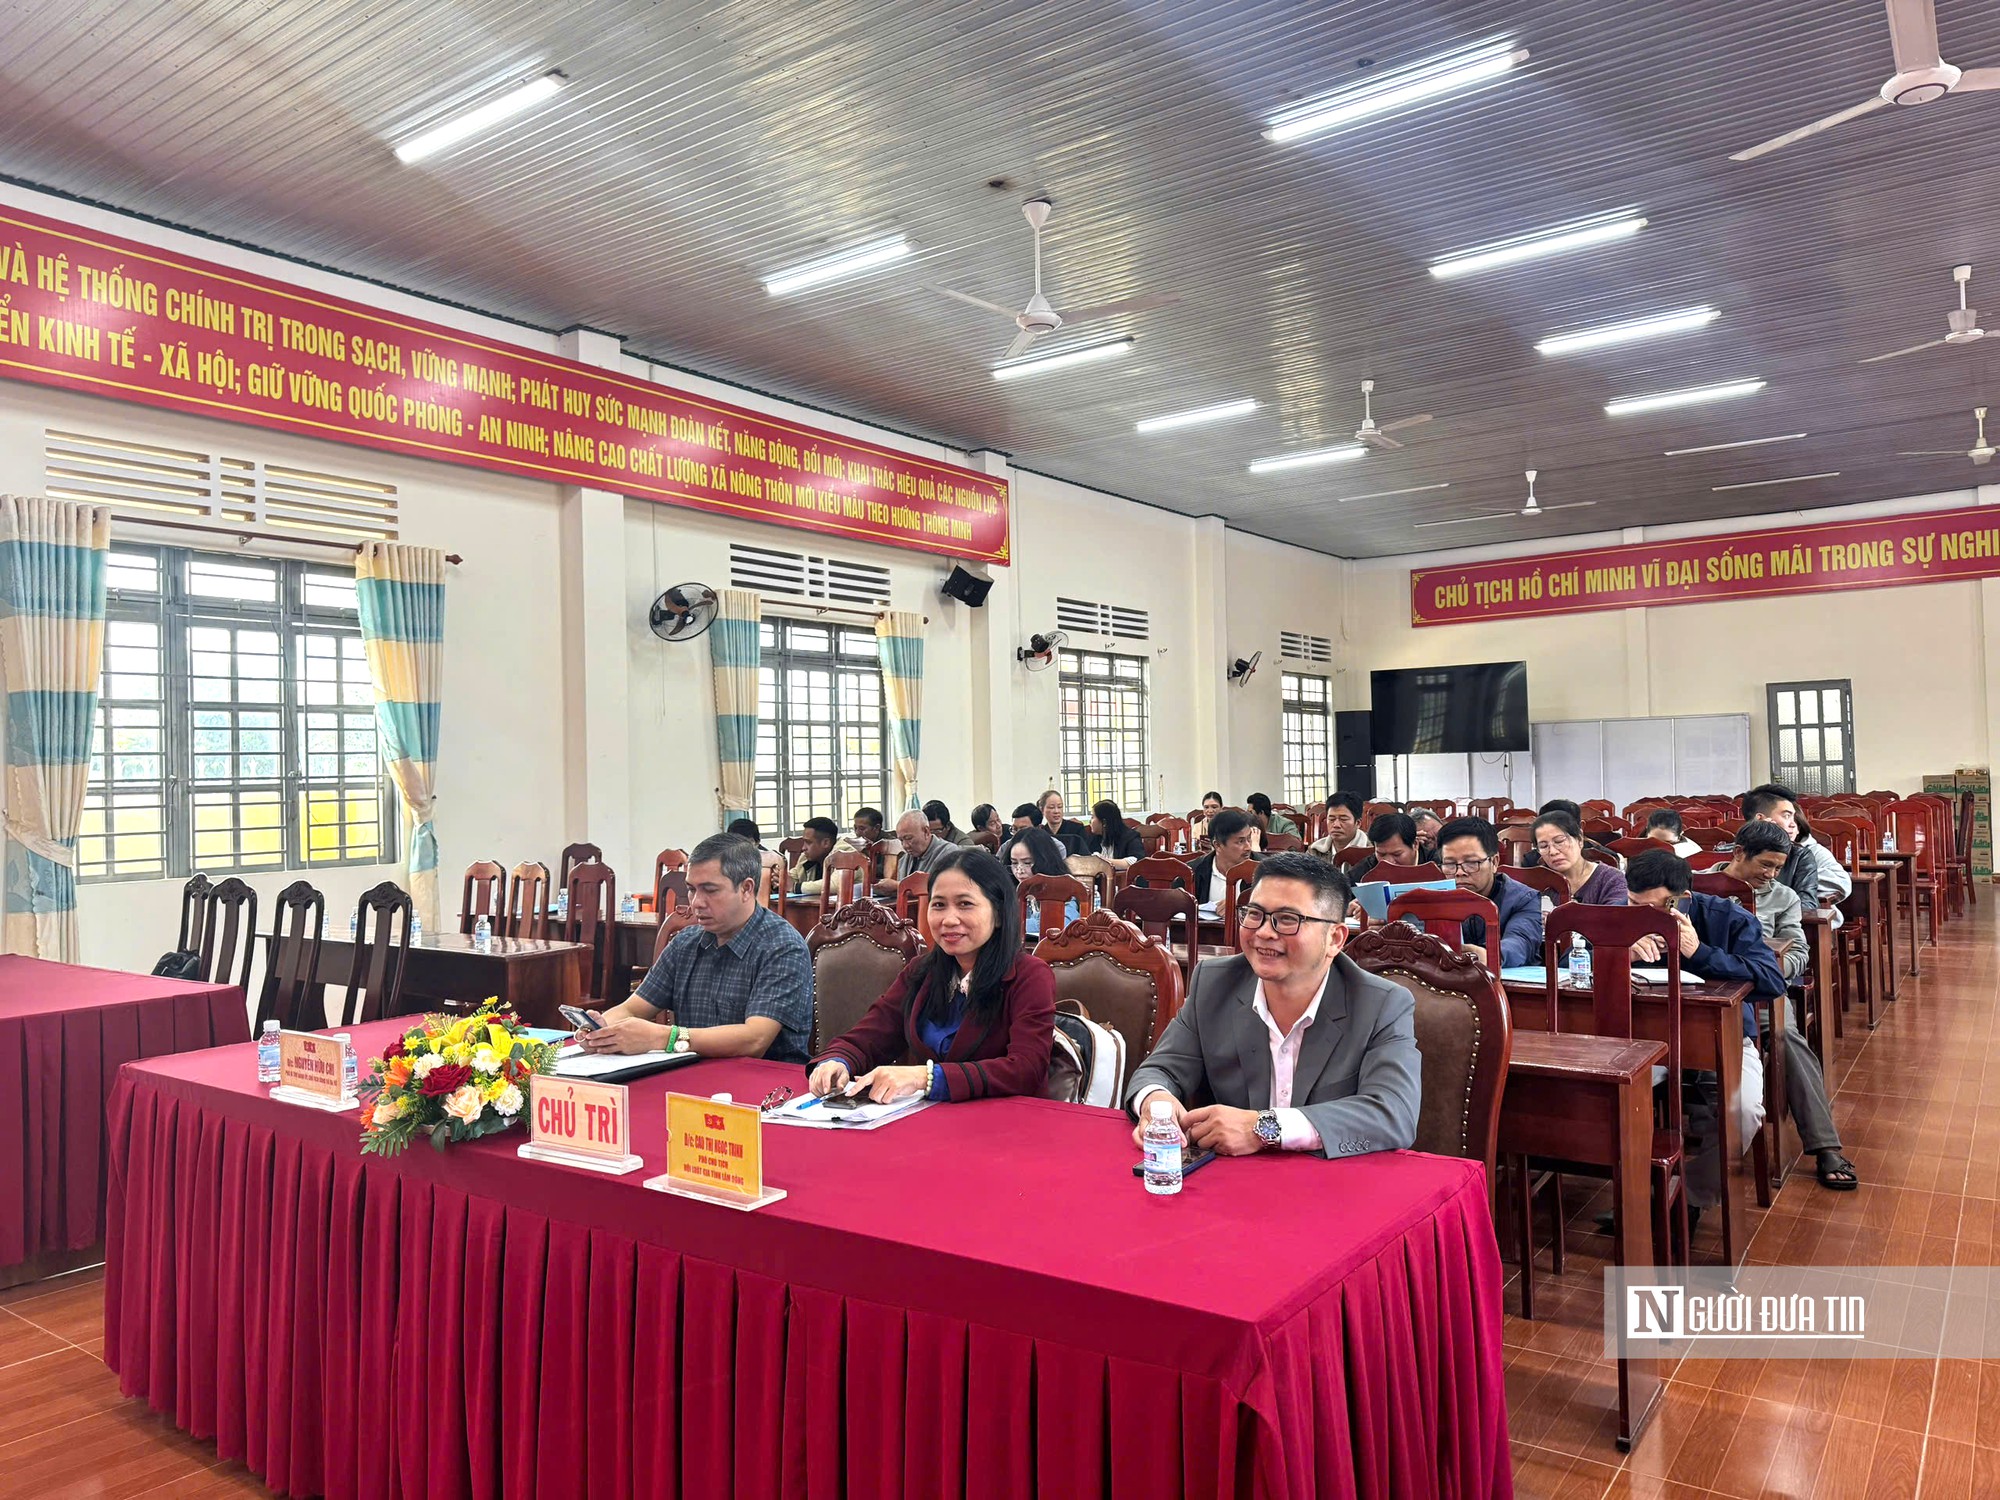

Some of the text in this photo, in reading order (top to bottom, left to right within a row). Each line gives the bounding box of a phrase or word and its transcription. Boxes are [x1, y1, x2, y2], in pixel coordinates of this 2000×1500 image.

[38, 253, 69, 302] HỆ
[78, 264, 157, 316] THỐNG
[166, 288, 234, 335] CHÍNH
[241, 307, 273, 351] TRỊ
[280, 317, 345, 361] TRONG
[352, 336, 406, 379] SẠCH,
[411, 348, 457, 388] VỮNG
[463, 363, 515, 404] MẠNH;
[521, 377, 559, 411] PHÁT
[564, 388, 591, 418] HUY
[595, 394, 623, 426] SỨC
[628, 404, 667, 437] MẠNH
[670, 415, 705, 446] ĐOÀN
[708, 421, 731, 455] KẾT,
[734, 430, 766, 461] NĂNG
[769, 439, 800, 472] ĐỘNG,
[804, 444, 820, 474] ĐỔI
[848, 461, 869, 486] KHAI
[872, 465, 895, 491] THÁC
[897, 472, 916, 499] HIỆU
[919, 475, 936, 500] QUẢ
[937, 480, 953, 504] CÁC
[983, 494, 997, 518] LỰC
[39, 315, 100, 362] KINH
[107, 326, 137, 369] TẾ
[160, 341, 191, 381] XÃ
[197, 349, 241, 395] HỘI;
[248, 362, 285, 400] GIỮ
[289, 370, 342, 412] VỮNG
[349, 382, 398, 423] QUỐC
[403, 396, 462, 437] PHÒNG
[479, 415, 501, 444] AN
[507, 421, 549, 457] NINH;
[553, 428, 595, 463] NÂNG
[599, 440, 626, 470] CAO
[629, 445, 663, 478] CHẤT
[667, 456, 707, 488] LƯỢNG
[711, 464, 727, 491] XÃ
[730, 468, 762, 499] NÔNG
[764, 477, 793, 505] THÔN
[795, 483, 815, 510] MỚI
[867, 501, 888, 525] THEO
[891, 505, 920, 531] HƯỚNG
[922, 509, 949, 536] THÔNG
[951, 518, 972, 541] MINH
[1434, 529, 2000, 609] CHỦ TỊCH HỒ CHÍ MINH VĨ ĐẠI SỐNG MÃI TRONG SỰ NGHI
[538, 1086, 618, 1145] CHỦ TRÌ
